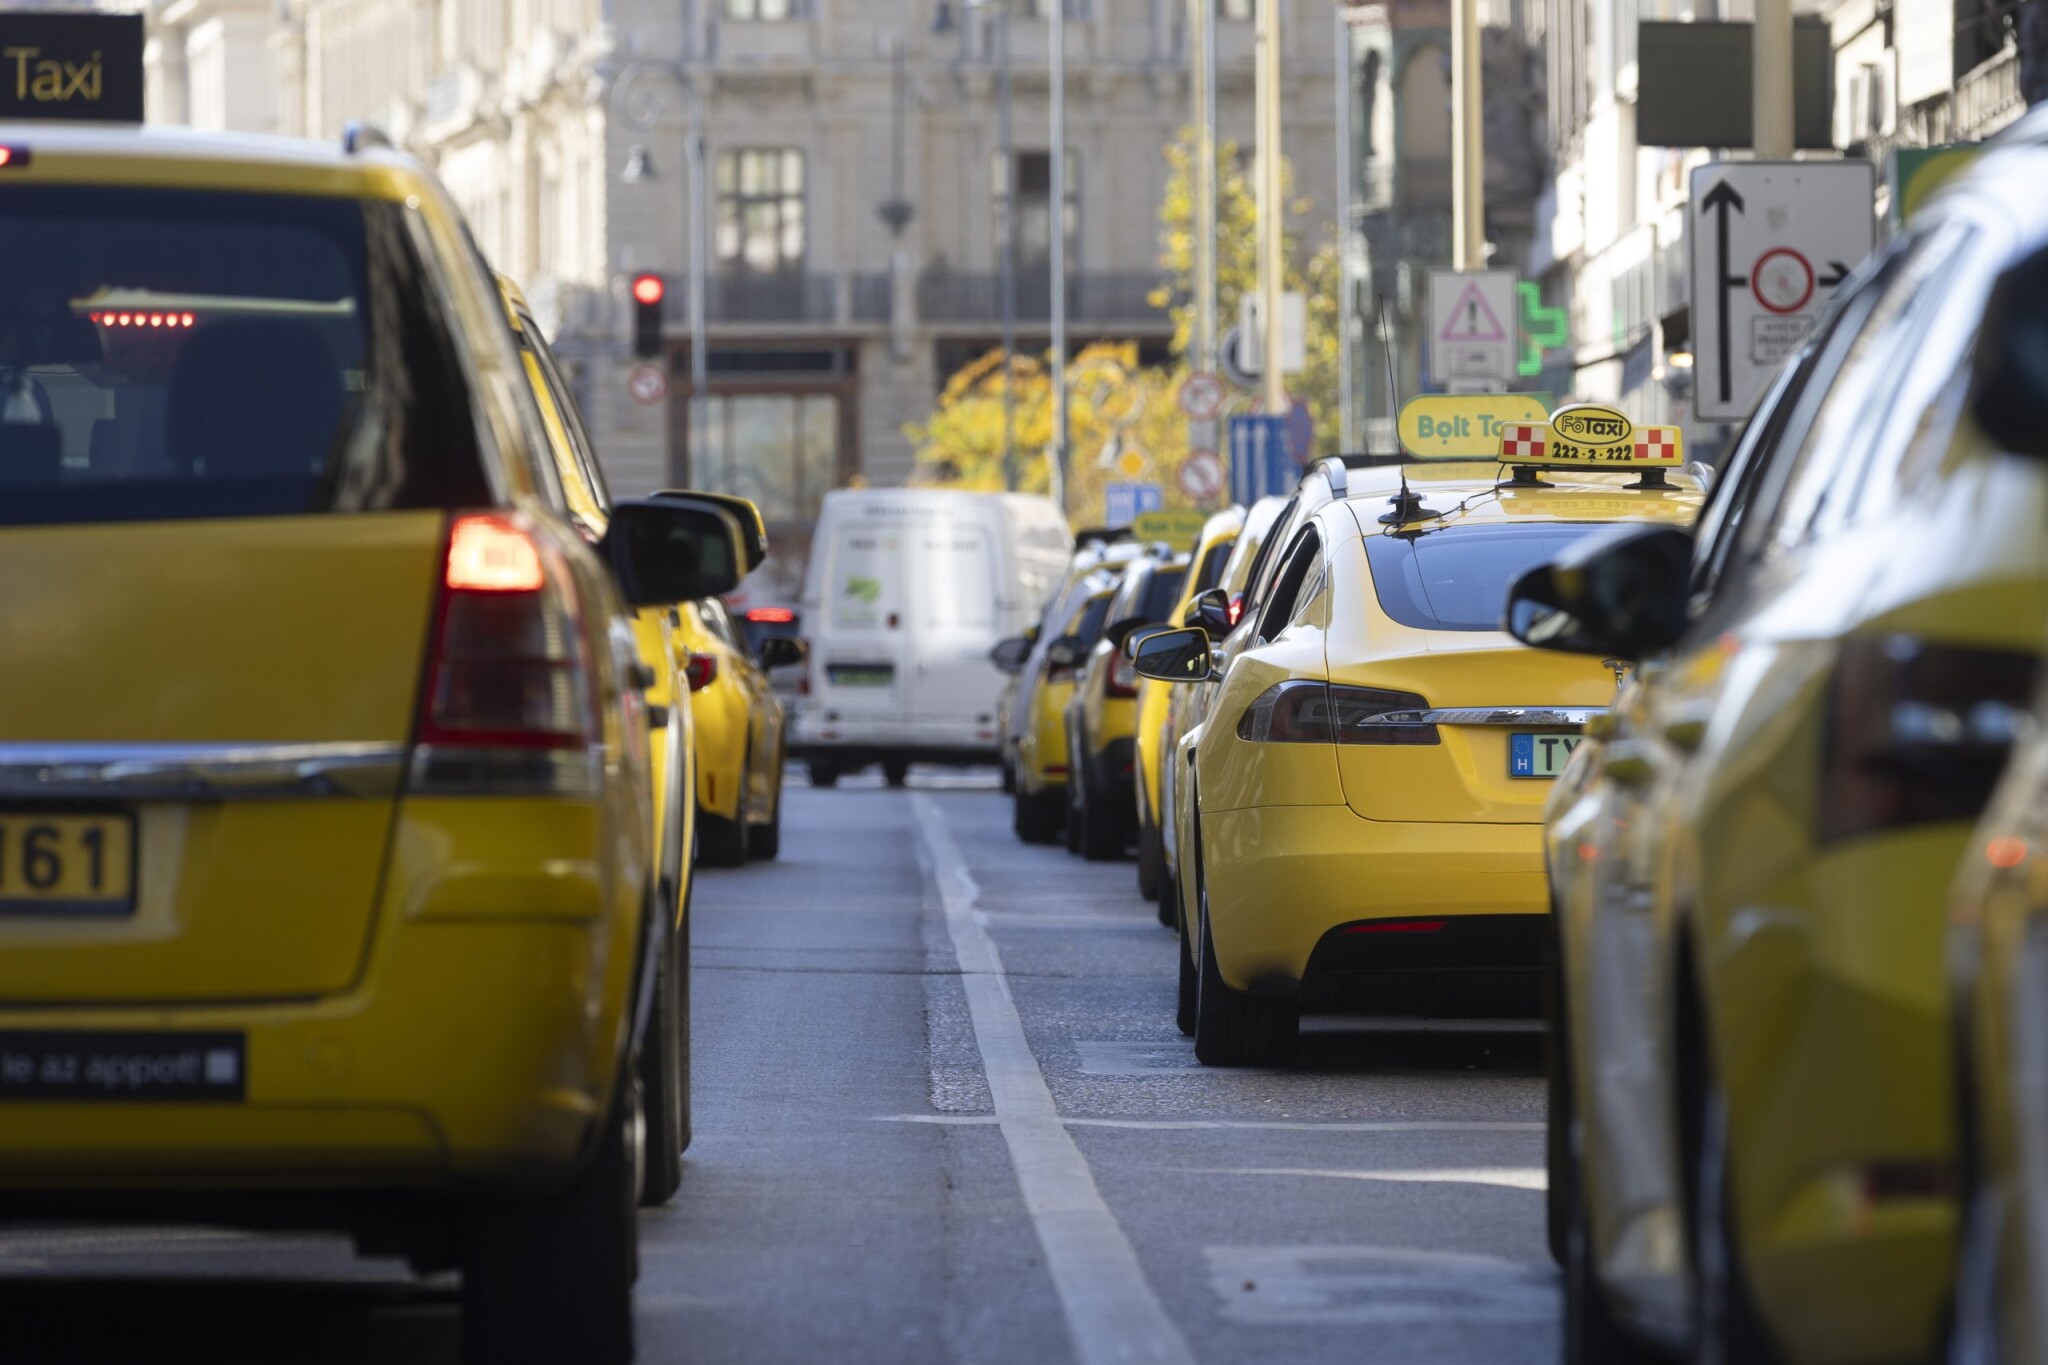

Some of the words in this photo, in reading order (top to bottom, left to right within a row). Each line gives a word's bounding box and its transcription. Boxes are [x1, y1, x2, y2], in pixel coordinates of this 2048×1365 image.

[4, 46, 103, 101] Taxi
[1418, 415, 1470, 445] Bolt
[1517, 758, 1528, 770] H
